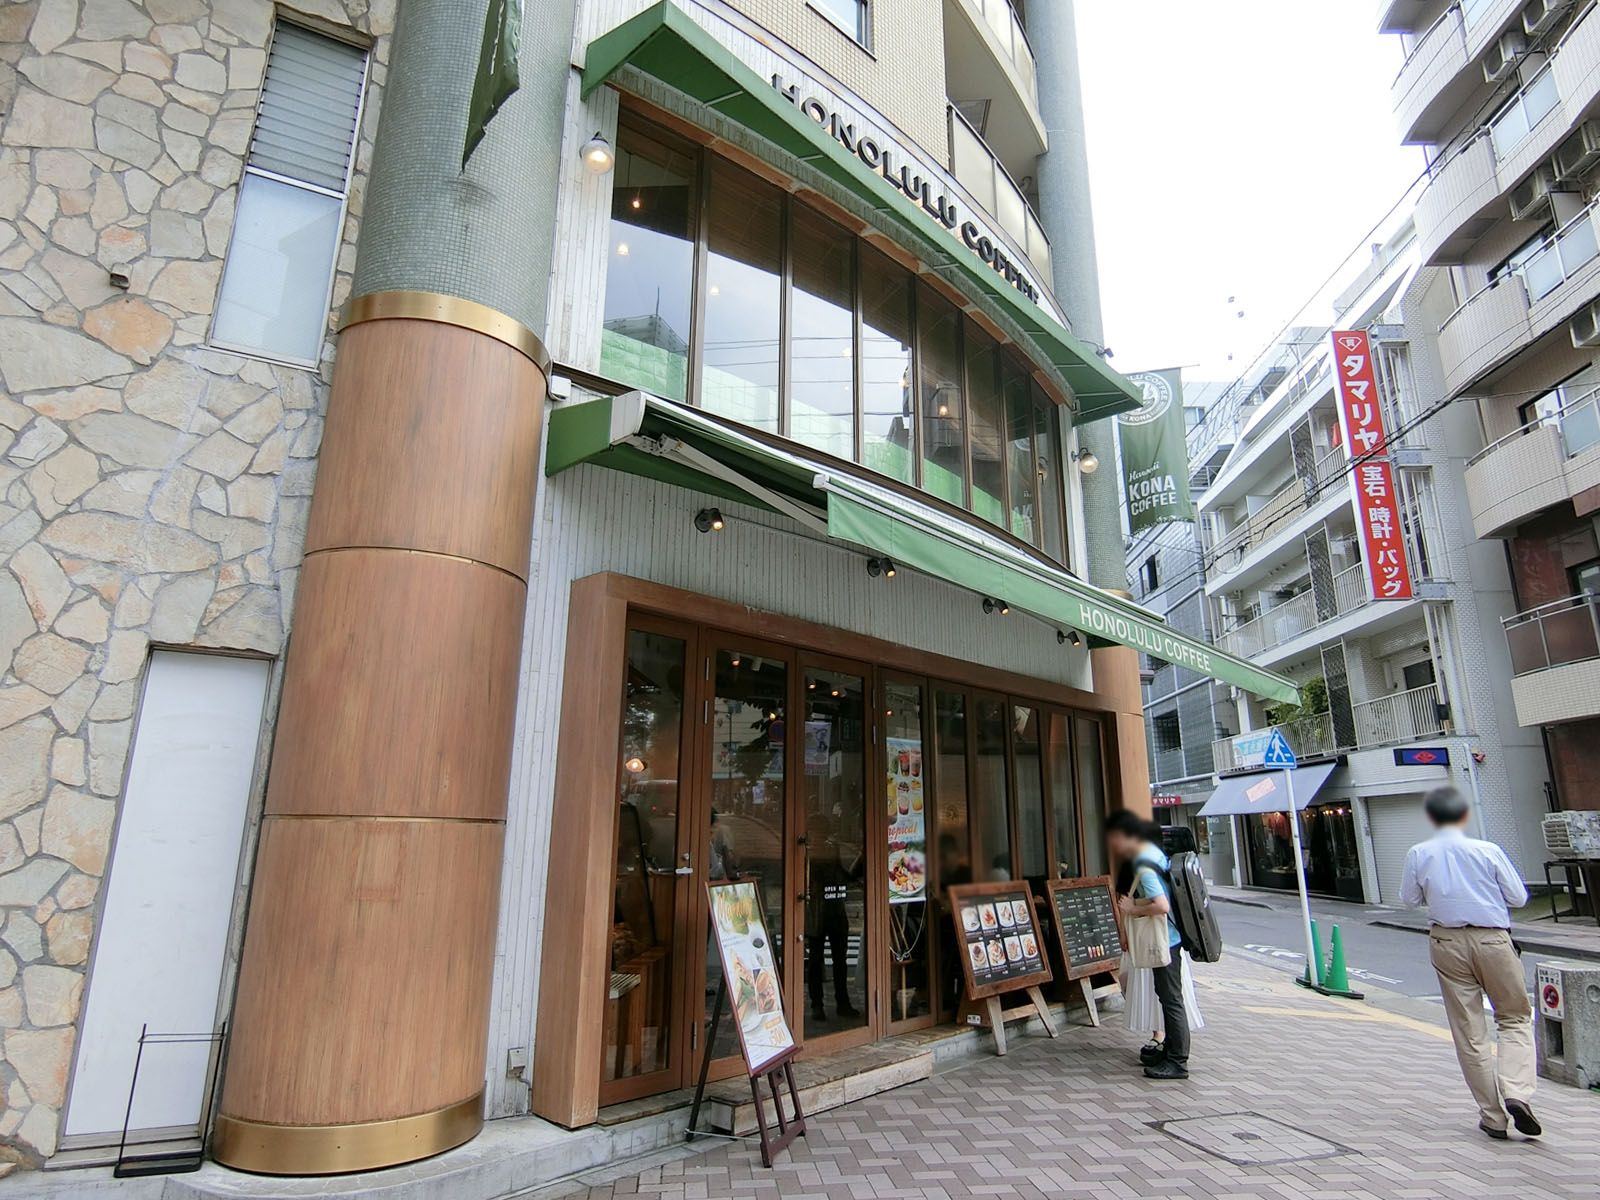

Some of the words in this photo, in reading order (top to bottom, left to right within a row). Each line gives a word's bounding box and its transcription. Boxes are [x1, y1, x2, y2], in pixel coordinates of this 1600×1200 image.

[771, 73, 957, 229] HONOLULU
[960, 221, 1039, 305] COFFEE
[1144, 374, 1168, 402] COFFEE
[1341, 353, 1380, 451] タマリヤ
[1128, 461, 1160, 482] Hawaii
[1129, 474, 1177, 502] KONA
[1131, 491, 1178, 517] COFFEE
[1361, 464, 1402, 599] 宝石・時計・バッグ
[1079, 602, 1162, 653] HONOLULU
[1164, 637, 1212, 673] COFFEE
